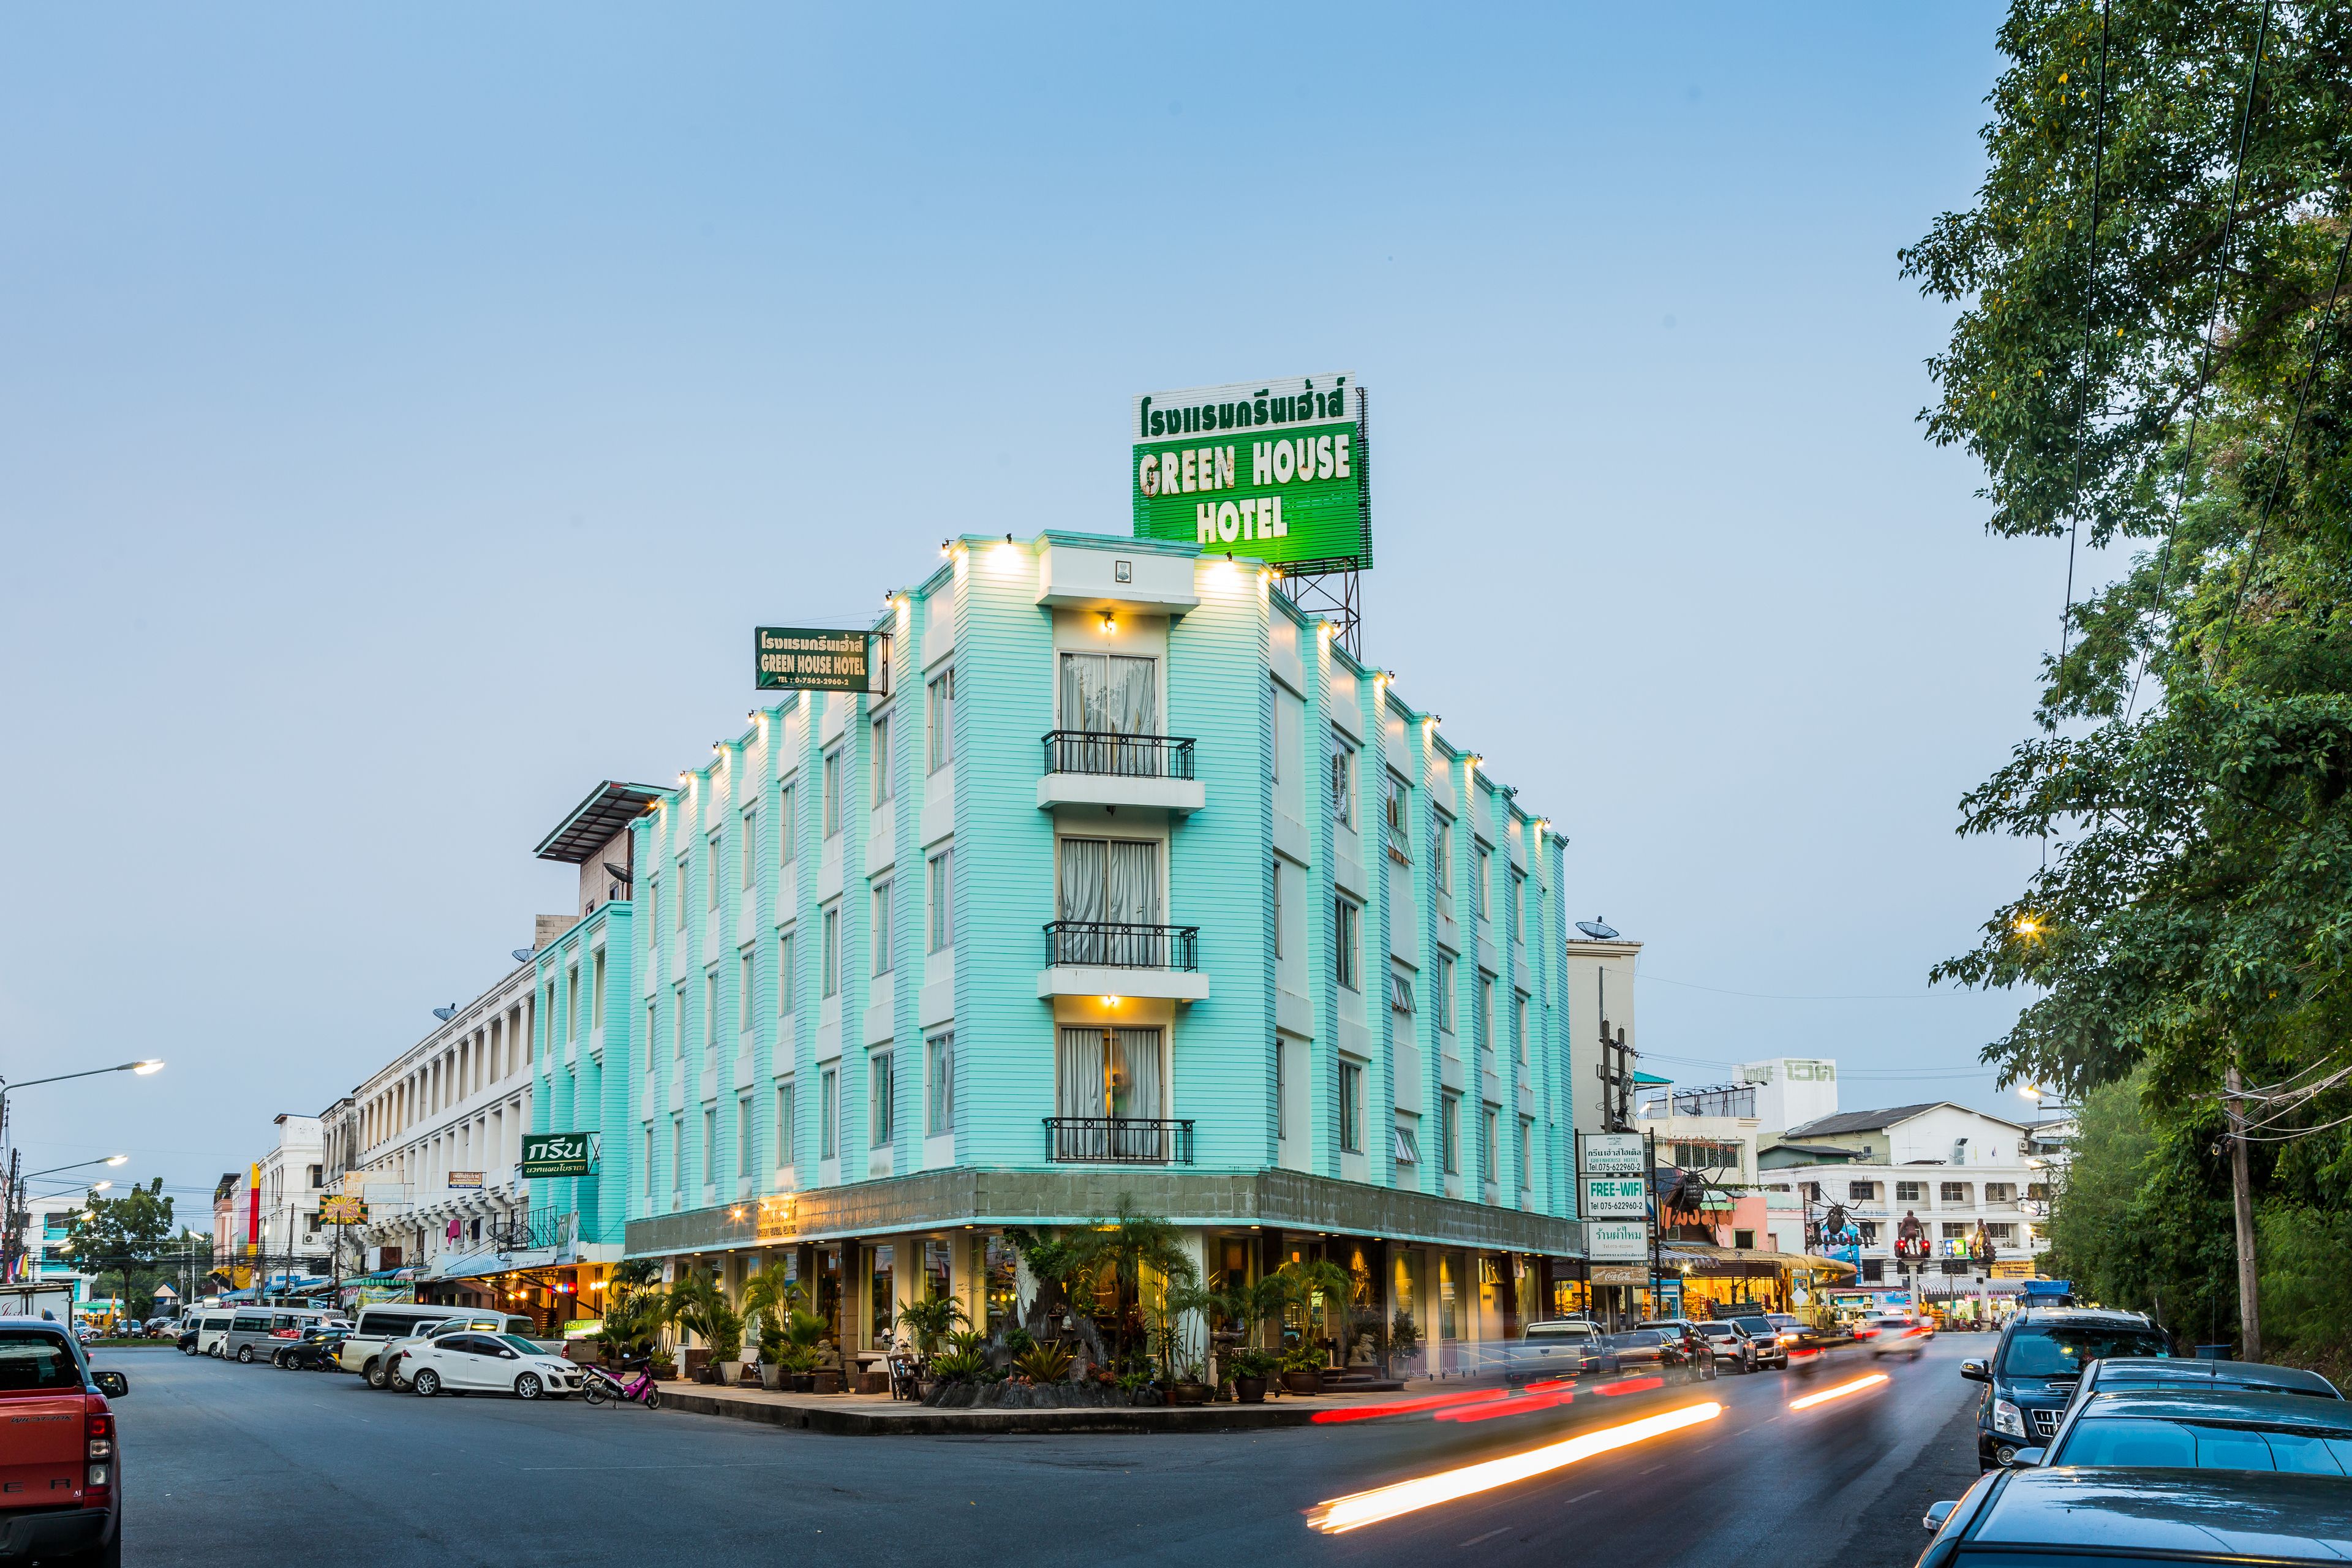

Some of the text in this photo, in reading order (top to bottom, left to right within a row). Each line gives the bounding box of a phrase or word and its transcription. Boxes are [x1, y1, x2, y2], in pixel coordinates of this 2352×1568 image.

[1140, 376, 1346, 437] โรงแรมกรีนเฮ้าส์
[1139, 434, 1351, 497] GREEN HOUSE
[1196, 496, 1288, 544] HOTEL
[761, 631, 864, 652] โรงแรมกรีนเฮ้าส์
[761, 654, 865, 676] GREEN HOUSE HOTEL
[795, 677, 849, 685] 0-7562-2960-2
[1743, 1066, 1774, 1082] VOGUE
[529, 1137, 583, 1160] กรีน
[526, 1163, 585, 1173] นวดแผนโบราณ
[1591, 1182, 1642, 1196] FREE-WIFI
[1596, 1226, 1641, 1240] ร้านผ้าไหม
[10, 1414, 75, 1423] WILDTRAK
